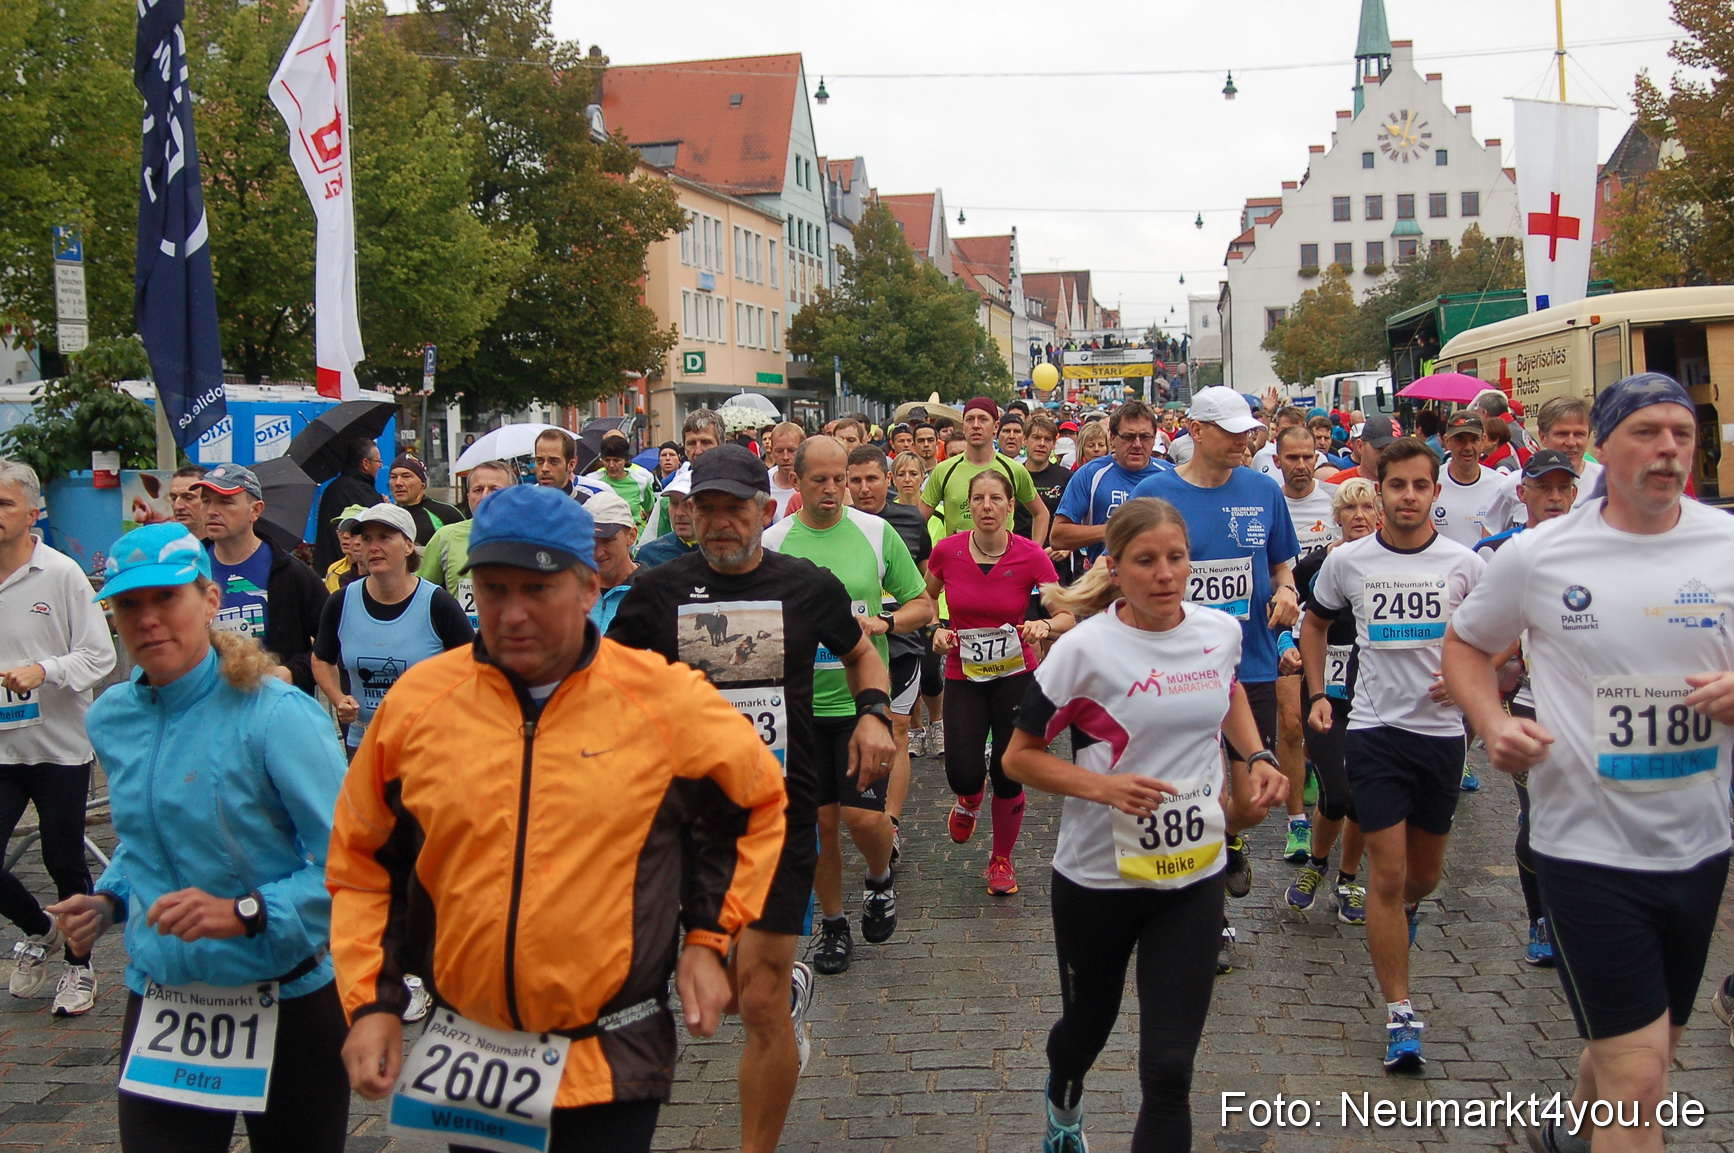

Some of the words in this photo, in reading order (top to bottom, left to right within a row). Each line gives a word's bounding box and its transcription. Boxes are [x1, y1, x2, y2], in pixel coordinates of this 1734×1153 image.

[686, 354, 702, 370] D
[1517, 346, 1566, 374] Bayerisches
[1092, 368, 1123, 376] START
[1516, 377, 1540, 396] Rotes
[1209, 566, 1243, 574] Neumarkt
[1190, 574, 1247, 602] 2660
[1372, 592, 1441, 620] 2495
[1561, 614, 1598, 624] PARTL
[978, 630, 1008, 638] Neumarkt
[1382, 626, 1431, 638] Christian
[971, 637, 1007, 662] 377
[982, 664, 1005, 674] Anika
[1166, 669, 1219, 684] MÜNCHEN
[1168, 680, 1222, 695] MARATHON
[1597, 688, 1640, 698] PARTL
[1645, 687, 1697, 698] Neumar
[1609, 704, 1712, 748] 3180
[1611, 752, 1702, 780] FRANK
[1137, 805, 1204, 850] 386
[1156, 857, 1194, 875] Heike
[147, 988, 188, 1004] PARTL
[190, 993, 254, 1006] Neumarkt
[598, 1001, 649, 1026] SYNERGY
[620, 1005, 661, 1026] SPORTS
[147, 1008, 259, 1060] 2601
[430, 1022, 472, 1044] PARTL
[475, 1037, 537, 1058] Neumarkt
[174, 1067, 222, 1090] Petra
[411, 1044, 542, 1119] 2602
[432, 1109, 508, 1137] Werner
